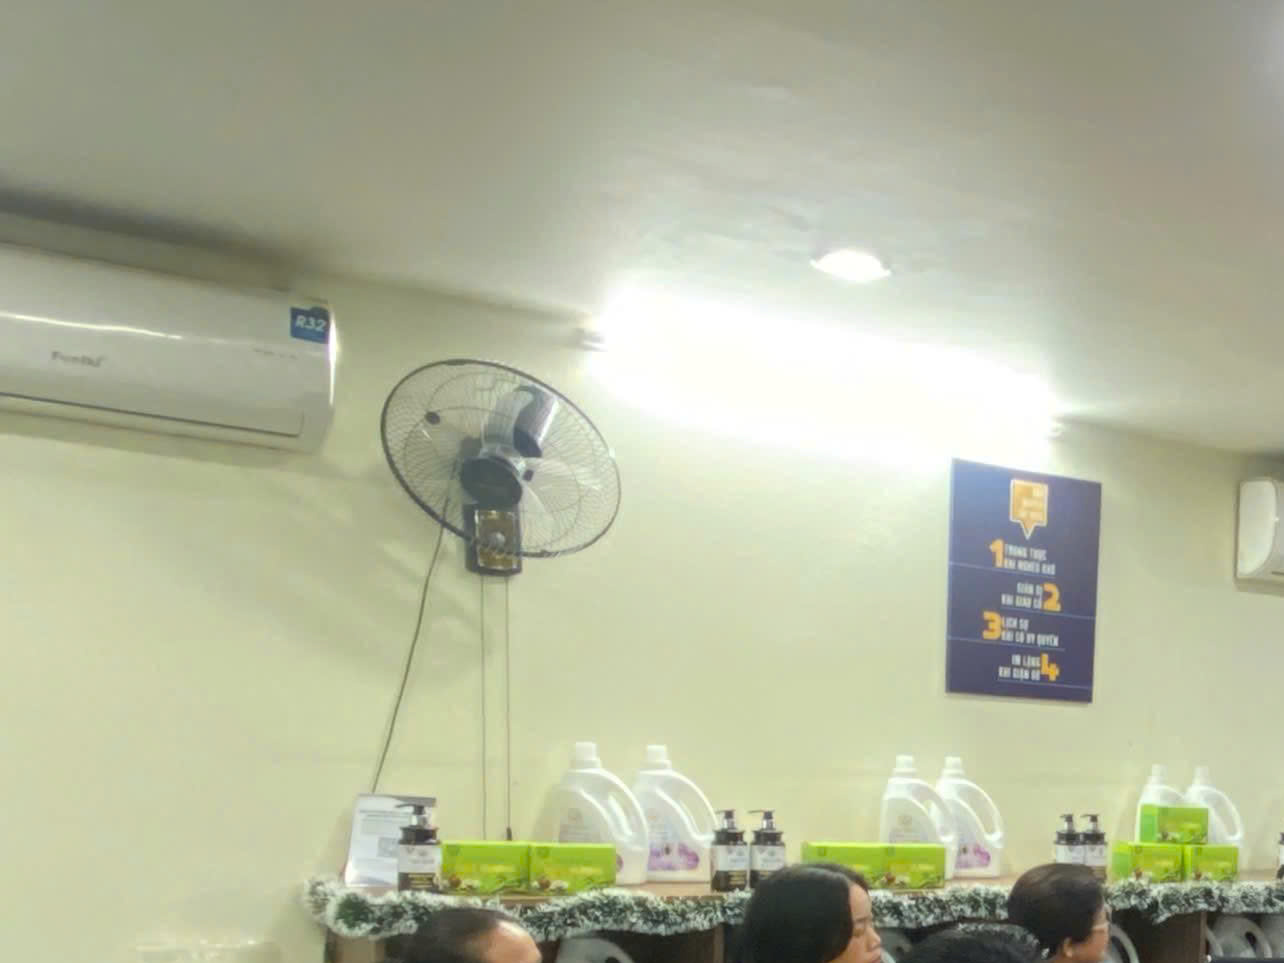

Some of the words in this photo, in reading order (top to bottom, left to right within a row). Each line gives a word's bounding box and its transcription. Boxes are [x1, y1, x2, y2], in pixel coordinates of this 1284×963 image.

[296, 315, 327, 332] R32
[988, 539, 1004, 568] 1
[1043, 582, 1062, 612] 2
[983, 611, 1002, 640] 3
[1041, 653, 1060, 681] 4
